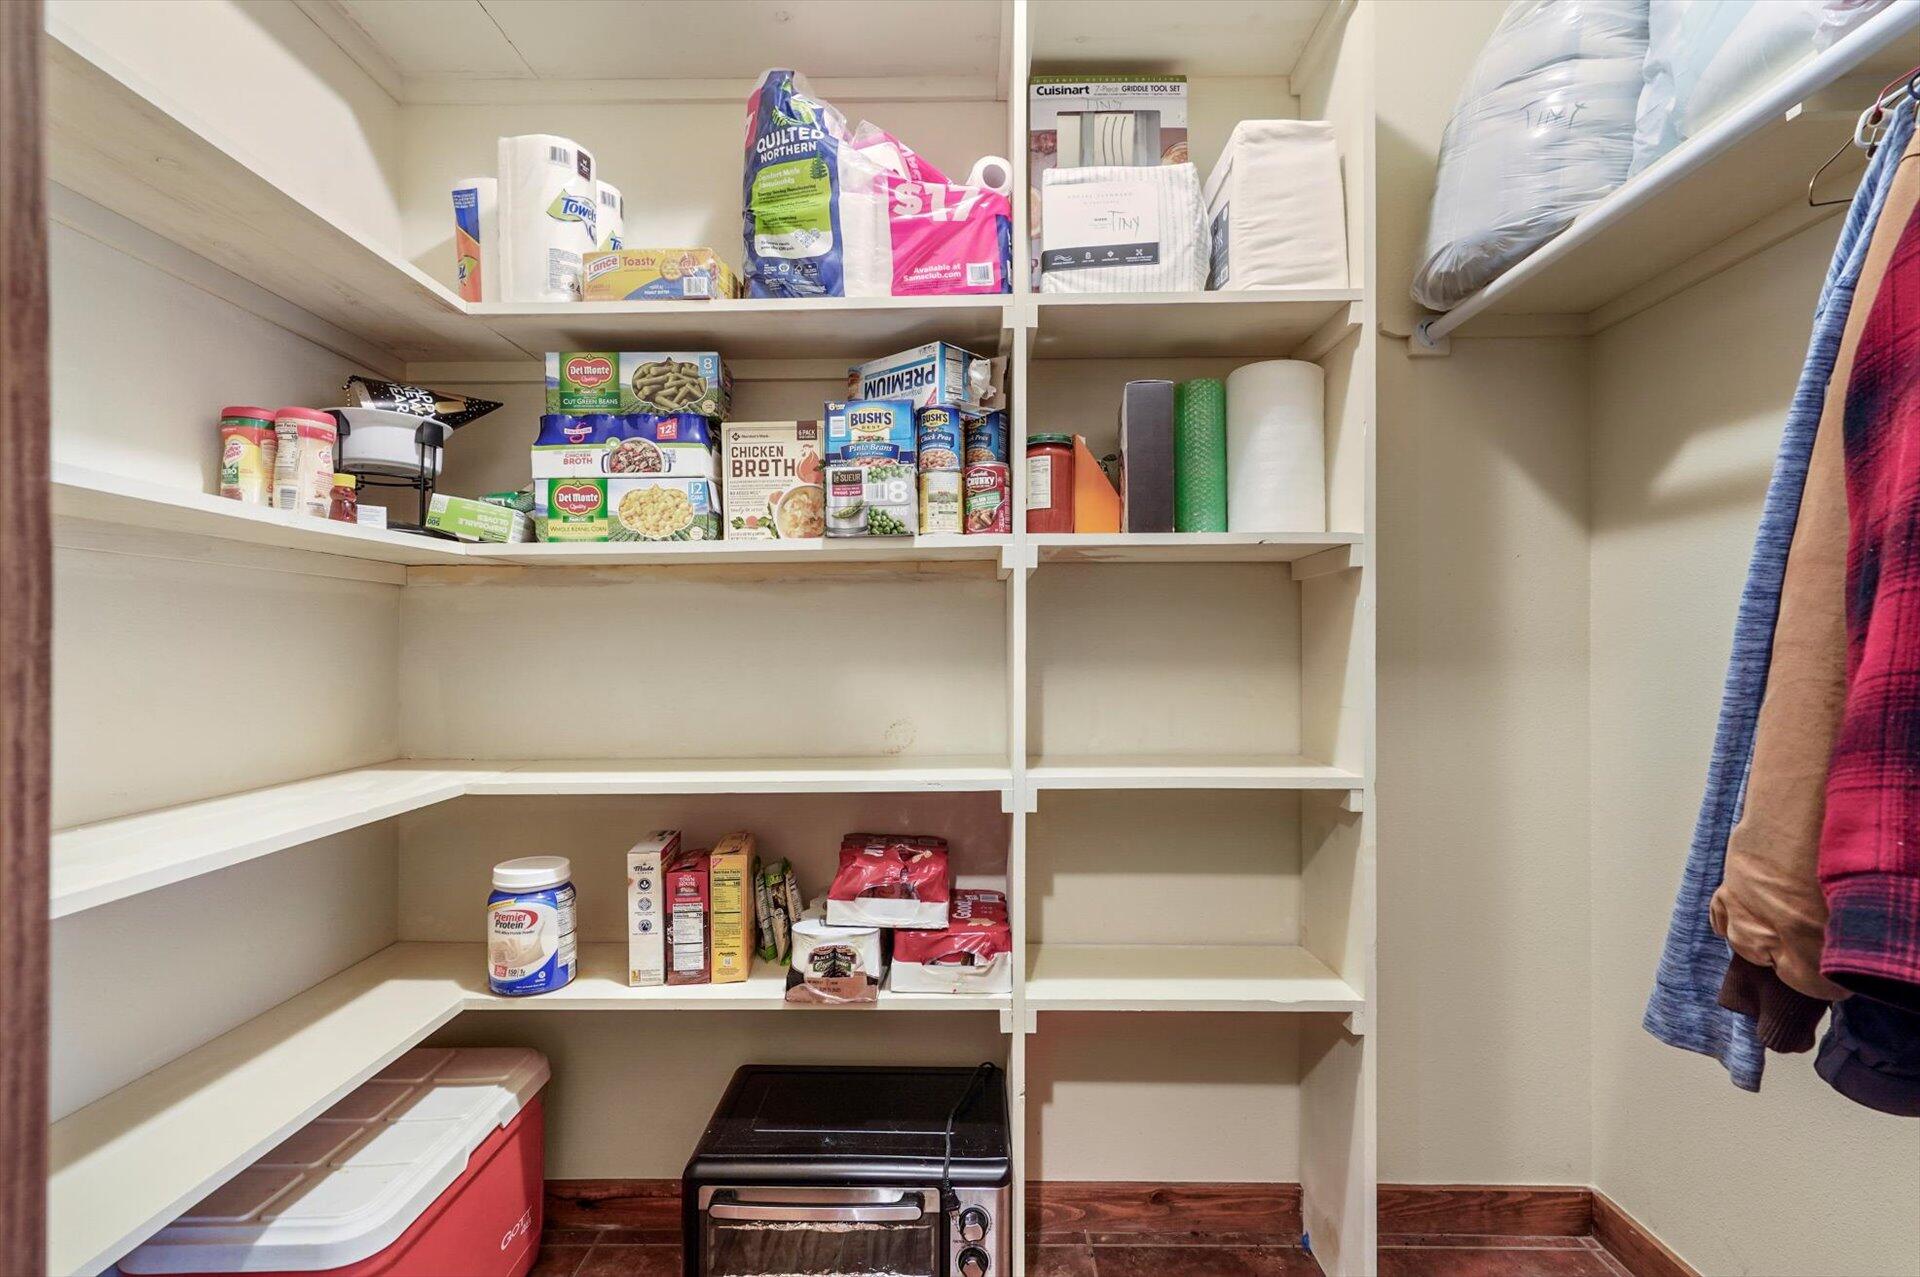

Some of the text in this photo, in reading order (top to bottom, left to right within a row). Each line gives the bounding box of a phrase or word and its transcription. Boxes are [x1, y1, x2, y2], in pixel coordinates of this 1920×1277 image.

[1036, 85, 1090, 96] Cuisinart
[756, 126, 825, 154] QUILTED
[760, 140, 817, 163] NORTHERN
[1107, 209, 1140, 238] TINY
[588, 254, 619, 275] Lance
[622, 256, 656, 267] Toasty
[913, 264, 951, 274] Available
[903, 271, 961, 282] Samsclub.com
[569, 365, 610, 375] Del Monte
[703, 357, 713, 370] 8
[864, 363, 936, 400] PREMIUM
[850, 412, 892, 427] BUSH'S
[731, 445, 784, 458] CHICKEN
[848, 443, 893, 453] Pinto Beans
[563, 457, 593, 465] BROTH
[731, 458, 796, 478] BROTH
[691, 482, 703, 495] 12
[888, 480, 908, 503] 8
[558, 493, 598, 502] Del Monte
[494, 911, 527, 922] Premier
[495, 919, 524, 930] Protein
